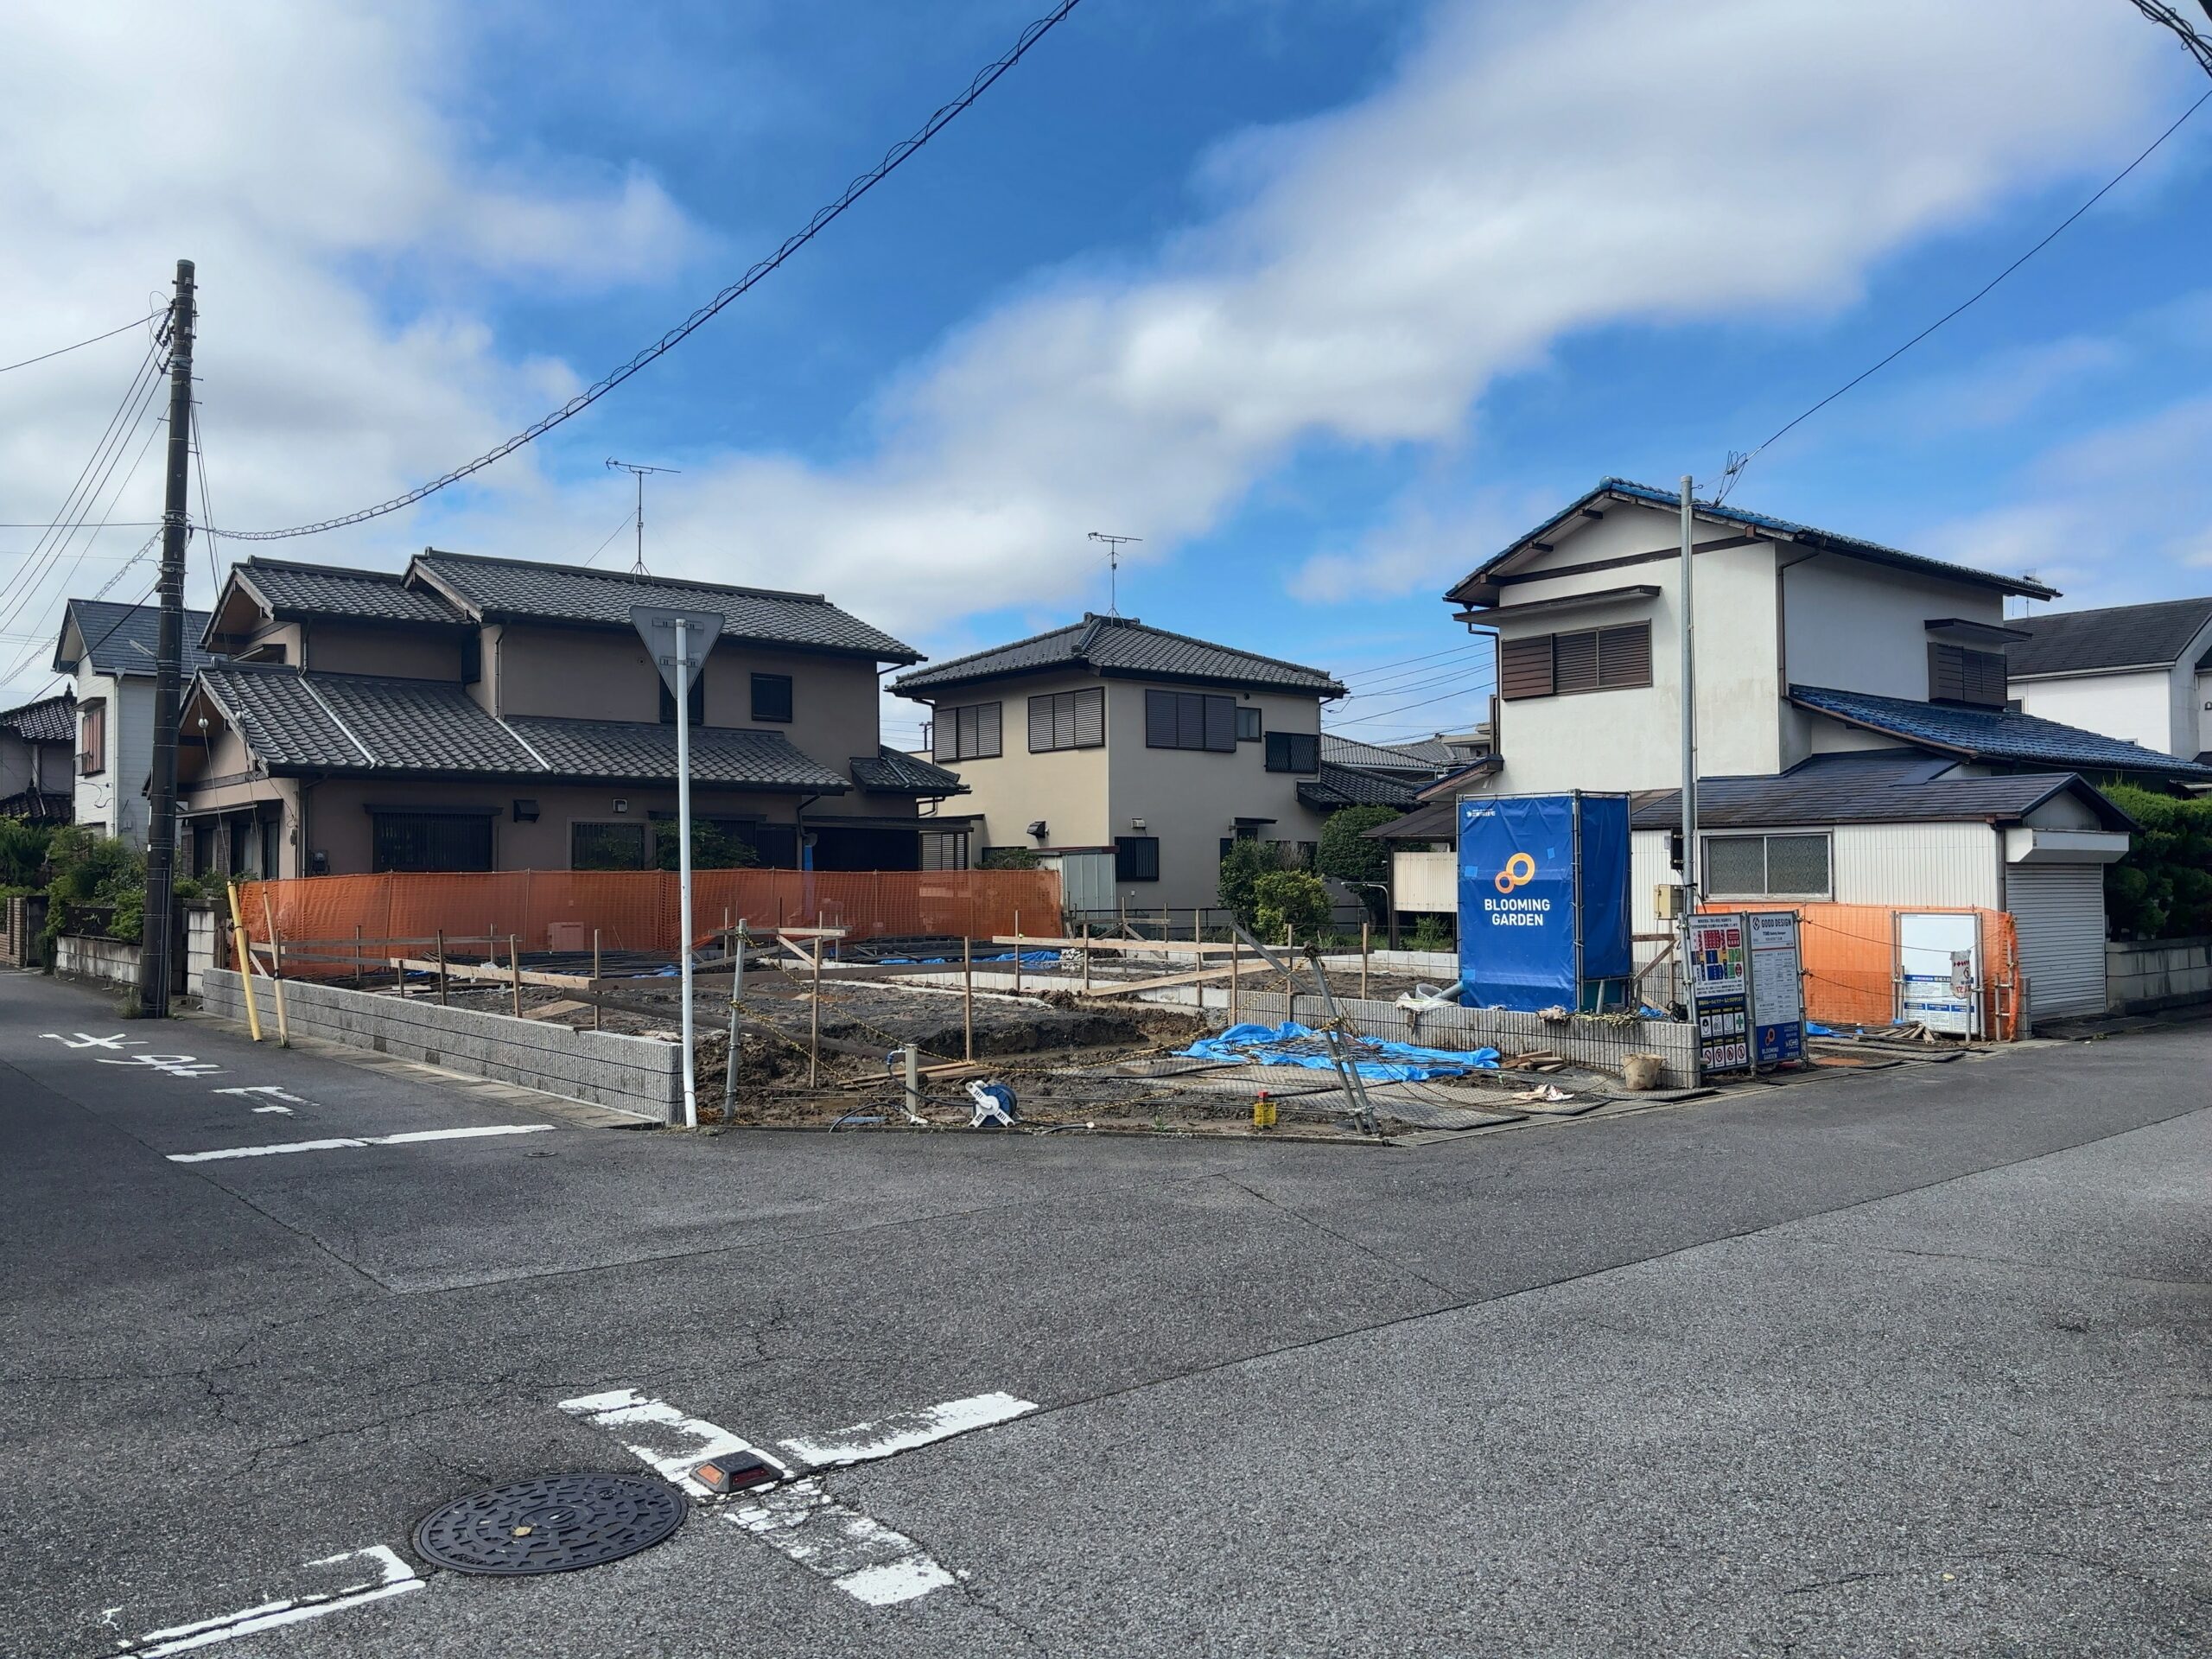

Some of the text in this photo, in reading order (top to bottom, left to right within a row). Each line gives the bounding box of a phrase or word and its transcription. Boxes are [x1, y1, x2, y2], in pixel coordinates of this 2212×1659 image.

[1484, 899, 1550, 912] BLOOMING
[1491, 913, 1543, 926] GARDEN
[1761, 918, 1791, 928] GOOD DESIGN
